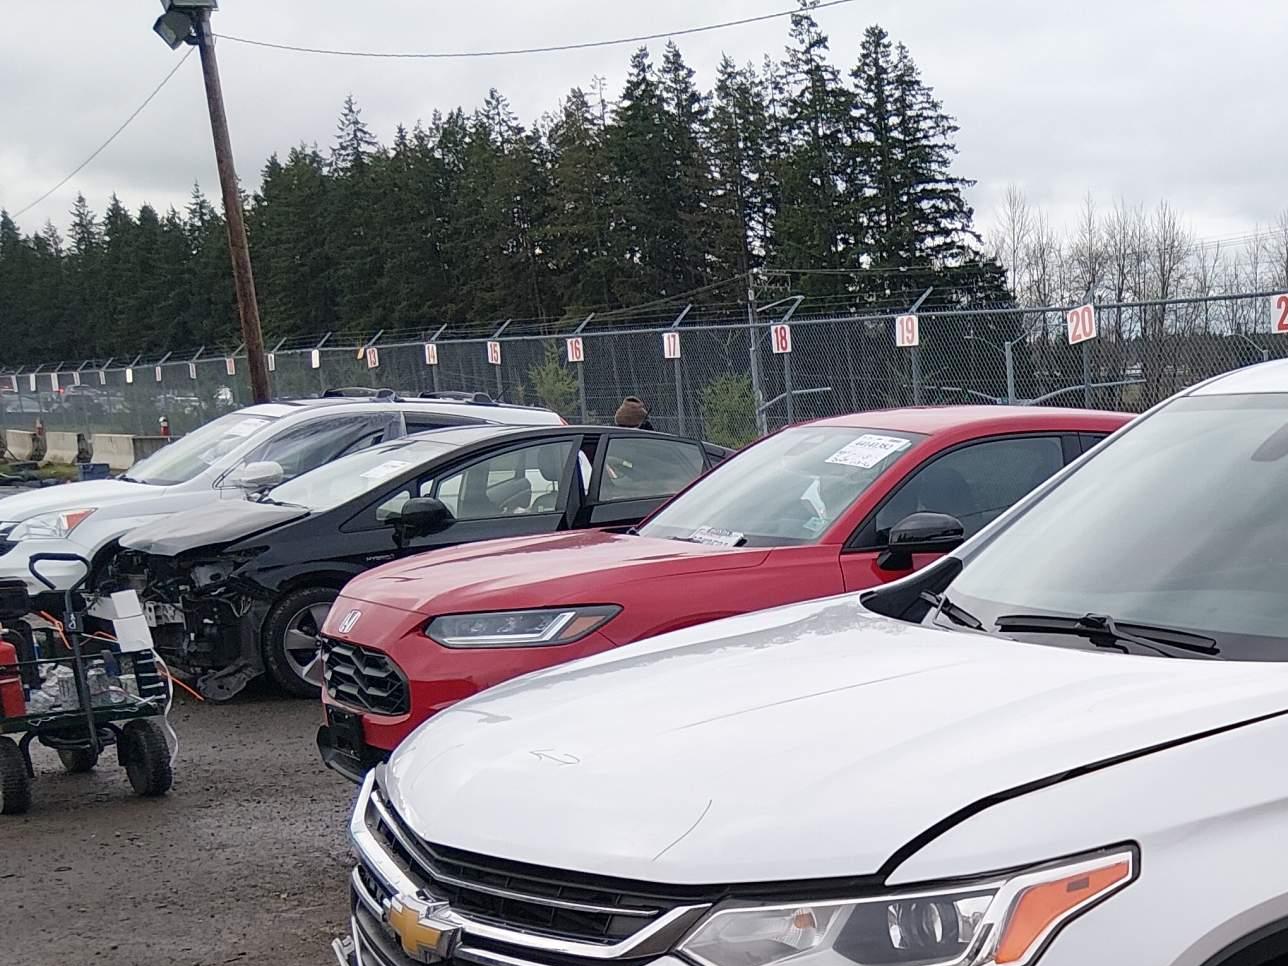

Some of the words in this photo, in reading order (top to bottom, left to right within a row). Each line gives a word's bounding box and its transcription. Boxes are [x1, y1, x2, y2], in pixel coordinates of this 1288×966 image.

[899, 316, 915, 344] 19
[1069, 306, 1094, 342] 20
[569, 339, 582, 360] 16
[667, 334, 677, 356] 17
[774, 327, 788, 351] 18
[489, 342, 499, 362] 15
